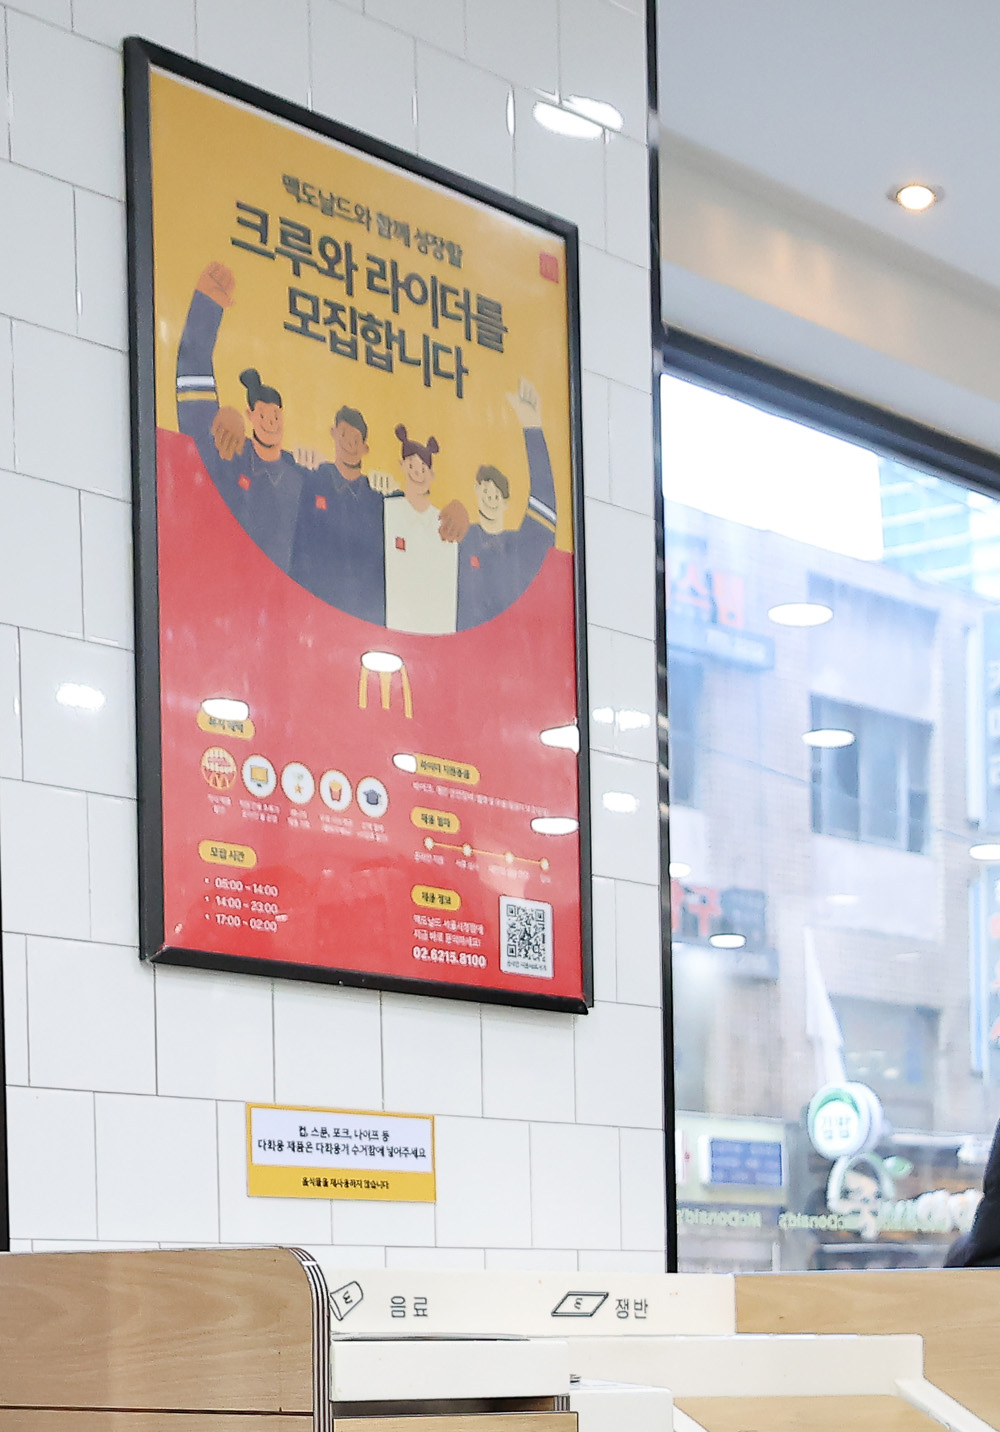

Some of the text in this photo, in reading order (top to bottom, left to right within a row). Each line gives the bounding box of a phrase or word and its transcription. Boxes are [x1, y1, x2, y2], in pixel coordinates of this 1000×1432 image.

[282, 173, 463, 269] 맥도날드와 함께 성장할
[231, 201, 509, 353] 크루와 라이더를
[283, 286, 469, 399] 모집합니다
[215, 877, 243, 891] 05:00
[252, 883, 278, 897] 14:00
[215, 896, 242, 909] 14:00
[251, 900, 279, 914] 23:00
[215, 914, 241, 927] 17:00
[249, 918, 277, 932] 02:00
[412, 945, 488, 969] 02.6215.8100
[354, 1128, 379, 1141] 나이프
[381, 1130, 390, 1142] 등
[286, 1140, 314, 1153] 제품은
[351, 1143, 385, 1157] 수거함에
[386, 1145, 426, 1159] 넣어주세요
[390, 1295, 428, 1319] 음료
[615, 1298, 649, 1320] 쟁반
